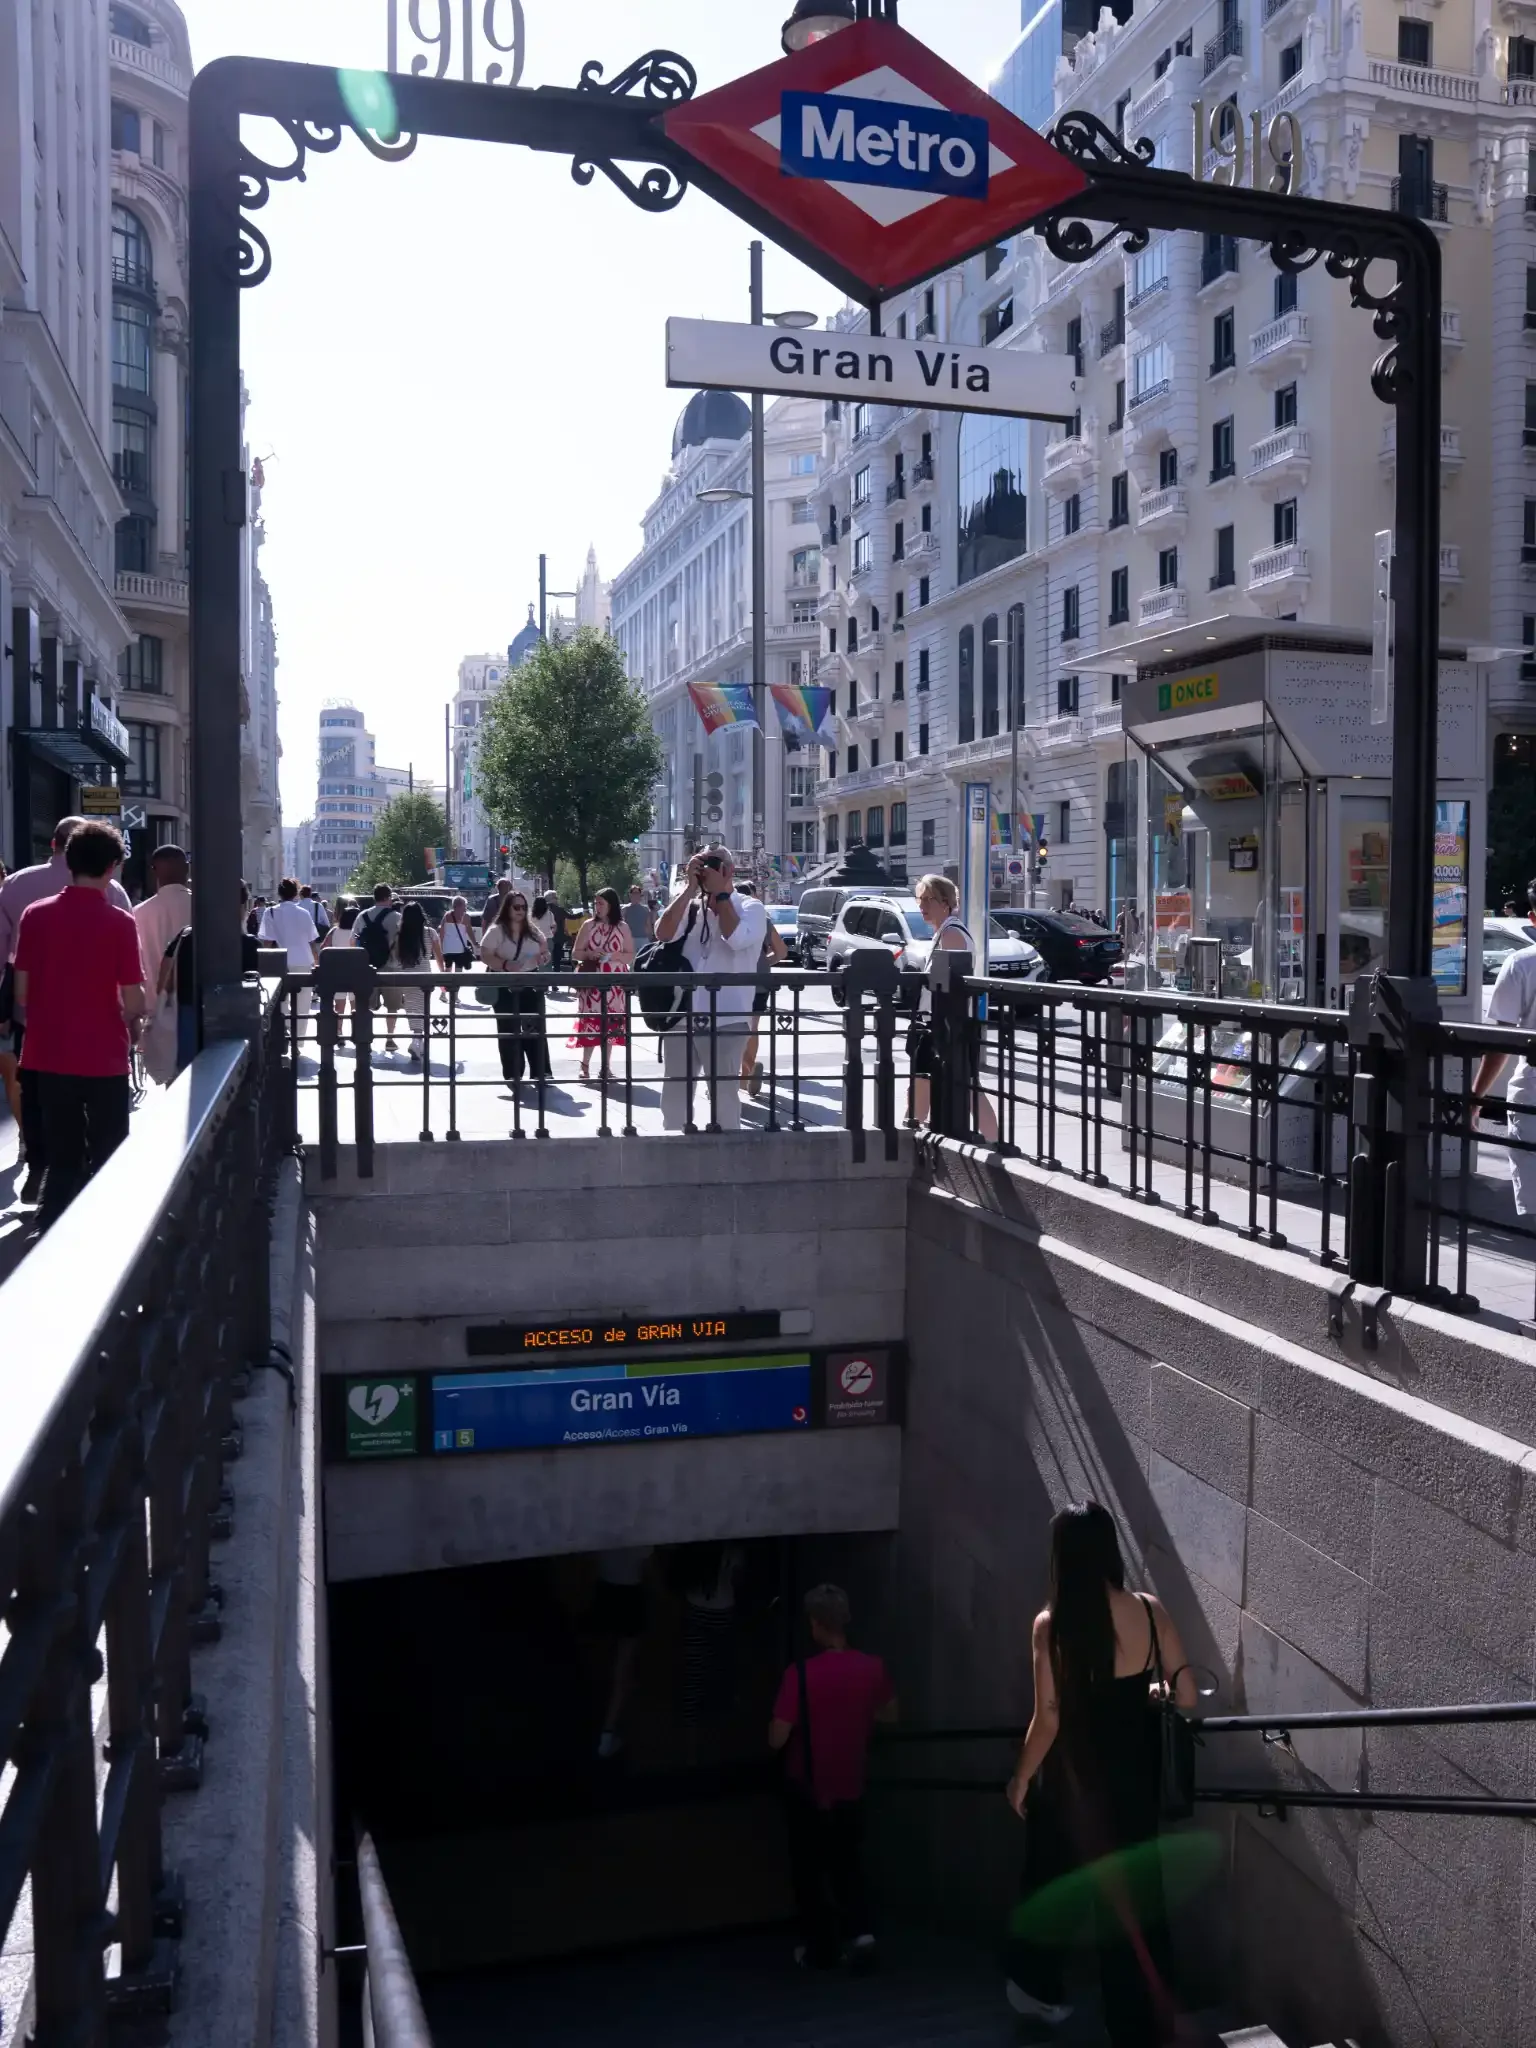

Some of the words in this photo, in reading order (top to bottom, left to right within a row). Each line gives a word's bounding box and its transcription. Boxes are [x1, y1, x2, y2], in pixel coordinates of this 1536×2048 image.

[387, 0, 525, 87] 1919
[802, 105, 976, 177] Metro
[1191, 99, 1302, 196] 1919
[769, 336, 893, 382] Gran
[914, 350, 990, 392] Vía
[1176, 678, 1213, 702] ONCE
[524, 1328, 593, 1347] ACCESO
[604, 1327, 626, 1342] de
[637, 1323, 682, 1340] GRAN
[692, 1321, 726, 1337] VIA
[570, 1389, 633, 1412] Gran
[641, 1383, 680, 1407] Vía
[460, 1431, 470, 1445] 5
[563, 1428, 640, 1441] Acceso/Access
[644, 1425, 669, 1436] Gran
[672, 1422, 688, 1433] Vía
